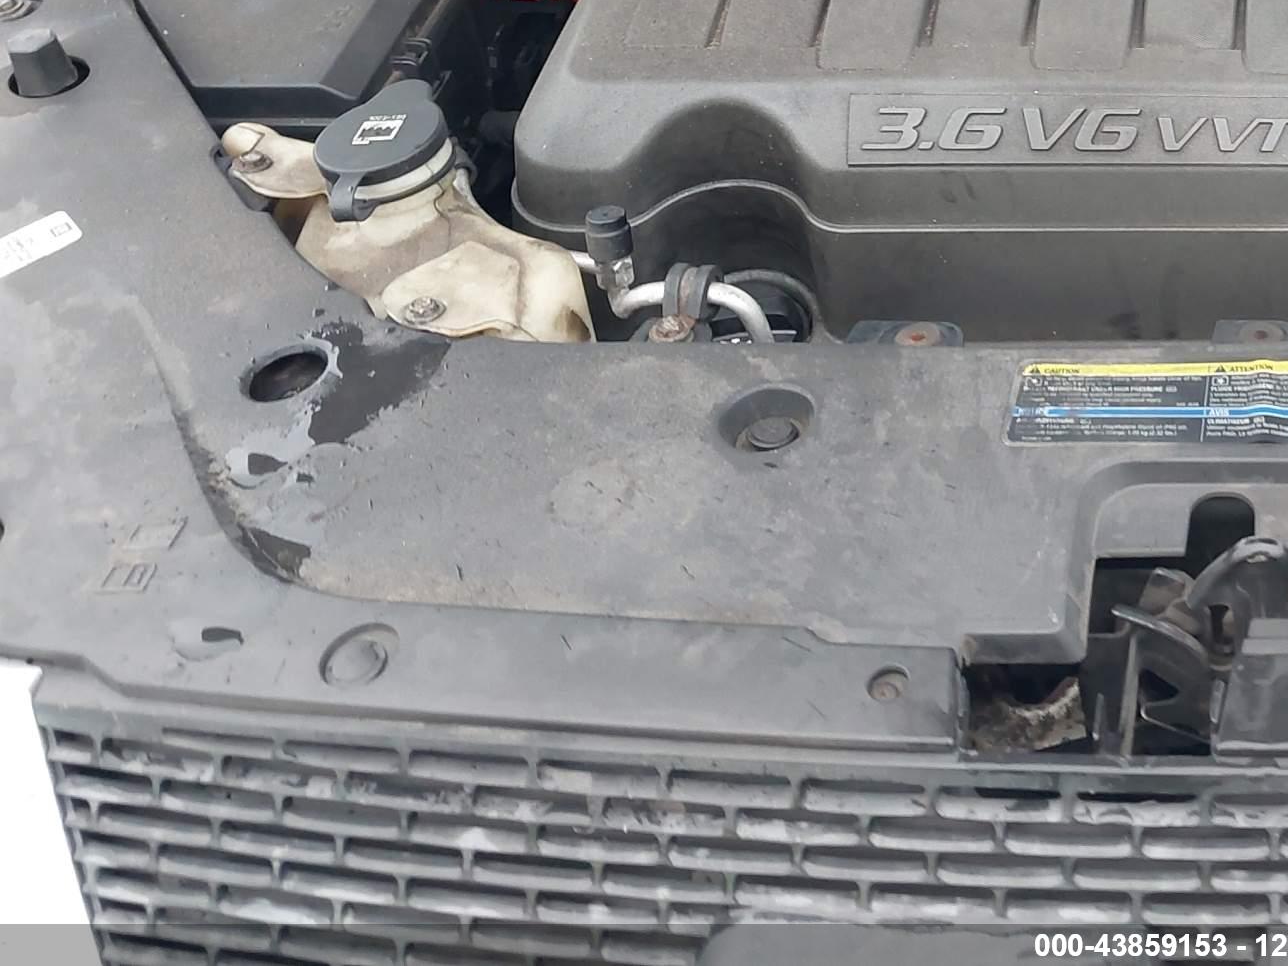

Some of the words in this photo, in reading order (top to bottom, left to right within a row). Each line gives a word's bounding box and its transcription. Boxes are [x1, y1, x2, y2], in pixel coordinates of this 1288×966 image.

[861, 106, 1007, 152] 3.6
[1021, 106, 1142, 152] V6
[1044, 367, 1080, 375] CAUTION
[1229, 363, 1274, 373] ATTENTION
